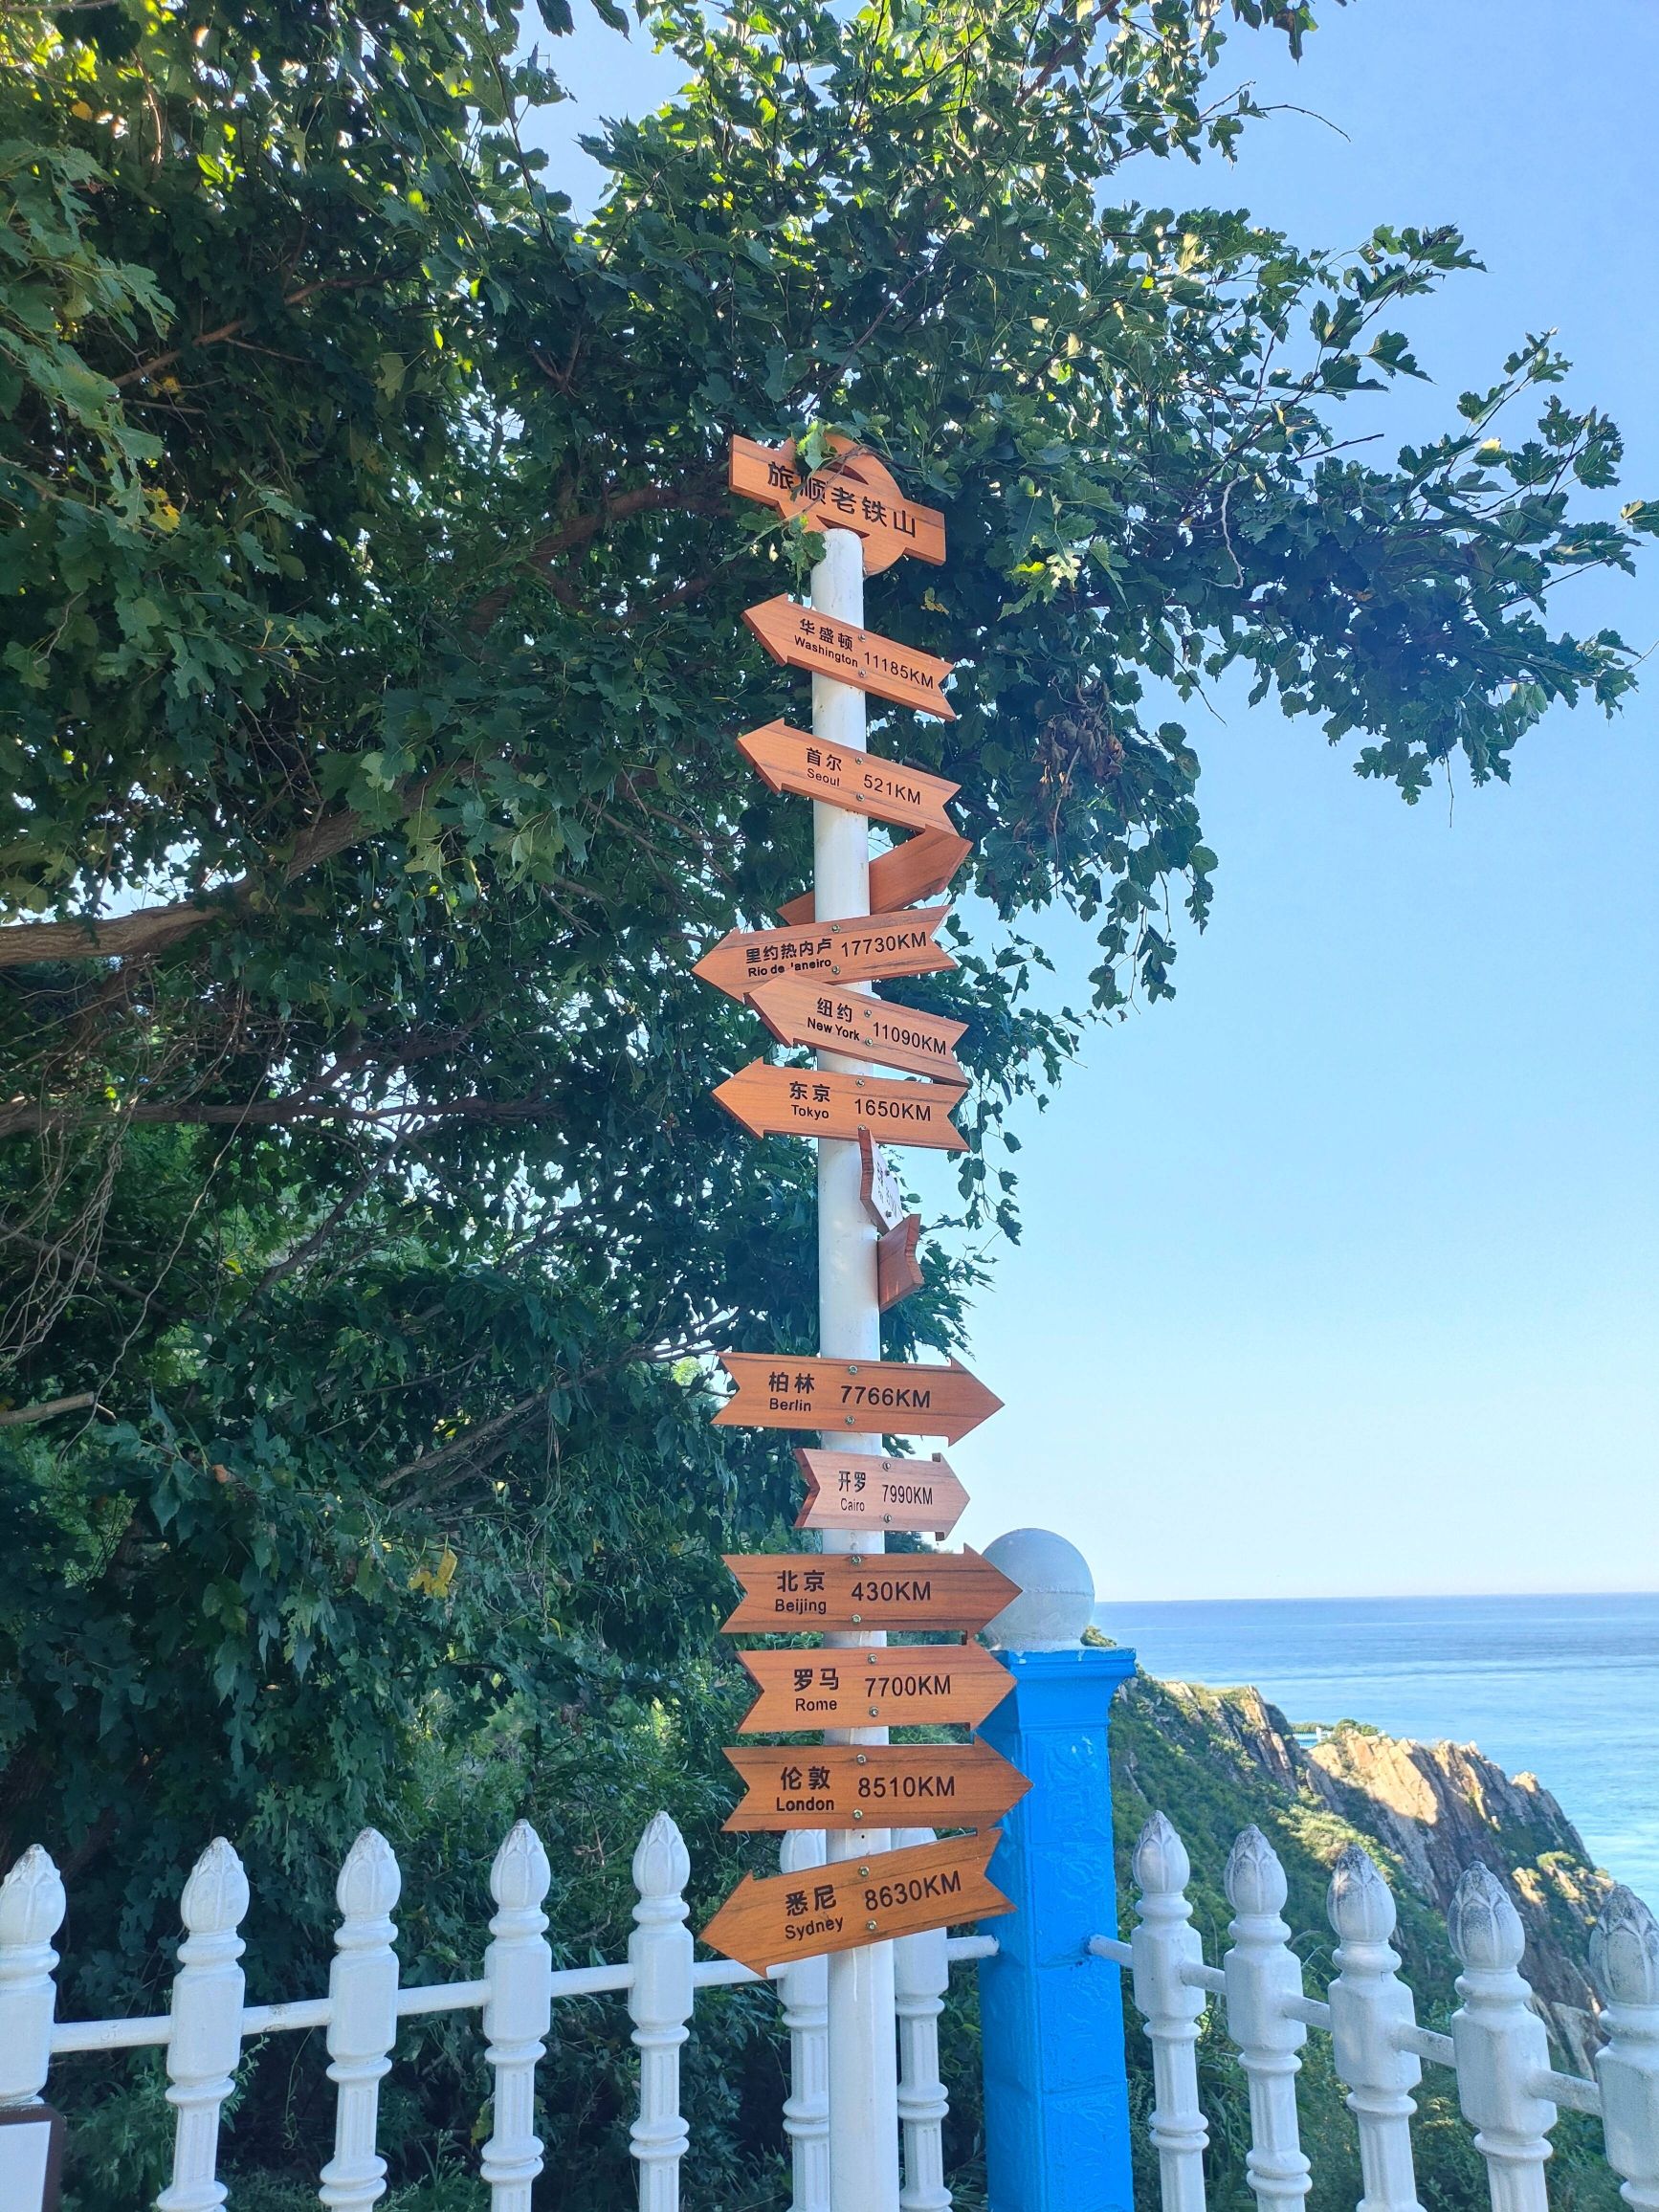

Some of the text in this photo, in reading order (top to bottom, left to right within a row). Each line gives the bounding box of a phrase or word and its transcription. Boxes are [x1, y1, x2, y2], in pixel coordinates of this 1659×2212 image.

[767, 460, 916, 539] 旅顺老铁山
[799, 617, 853, 653] 华盛顿
[794, 634, 859, 668] Washington
[864, 652, 934, 689] 11185KM
[806, 746, 842, 772] 首尔
[807, 767, 840, 786] Seoul
[863, 774, 920, 805] 521KM
[745, 938, 833, 964] 里约热内卢
[841, 931, 927, 958] 17730KM
[747, 966, 768, 977] Rio
[770, 964, 785, 974] de
[816, 997, 852, 1024] 纽约
[807, 1017, 860, 1042] New York
[873, 1022, 946, 1055] 11090KM
[789, 1081, 830, 1103] 东京
[790, 1104, 830, 1120] Tokyo
[854, 1098, 931, 1121] 1650KM
[768, 1371, 815, 1394] 柏林
[769, 1398, 811, 1412] Berlin
[841, 1385, 931, 1408] 7766KM
[838, 1471, 867, 1493] 开罗
[840, 1497, 865, 1512] Cairo
[882, 1484, 933, 1505] 7990KM
[777, 1570, 826, 1592] 北京
[851, 1581, 931, 1602] 430KM
[775, 1599, 827, 1615] Beijing
[793, 1668, 839, 1692] 罗马
[865, 1675, 951, 1697] 7700KM
[795, 1698, 837, 1713] Rome
[780, 1765, 830, 1790] 伦敦
[857, 1776, 955, 1798] 8510KM
[776, 1797, 834, 1812] London
[785, 1884, 837, 1916] 悉尼
[864, 1870, 962, 1912] 8630KM
[785, 1917, 844, 1941] Sydney
